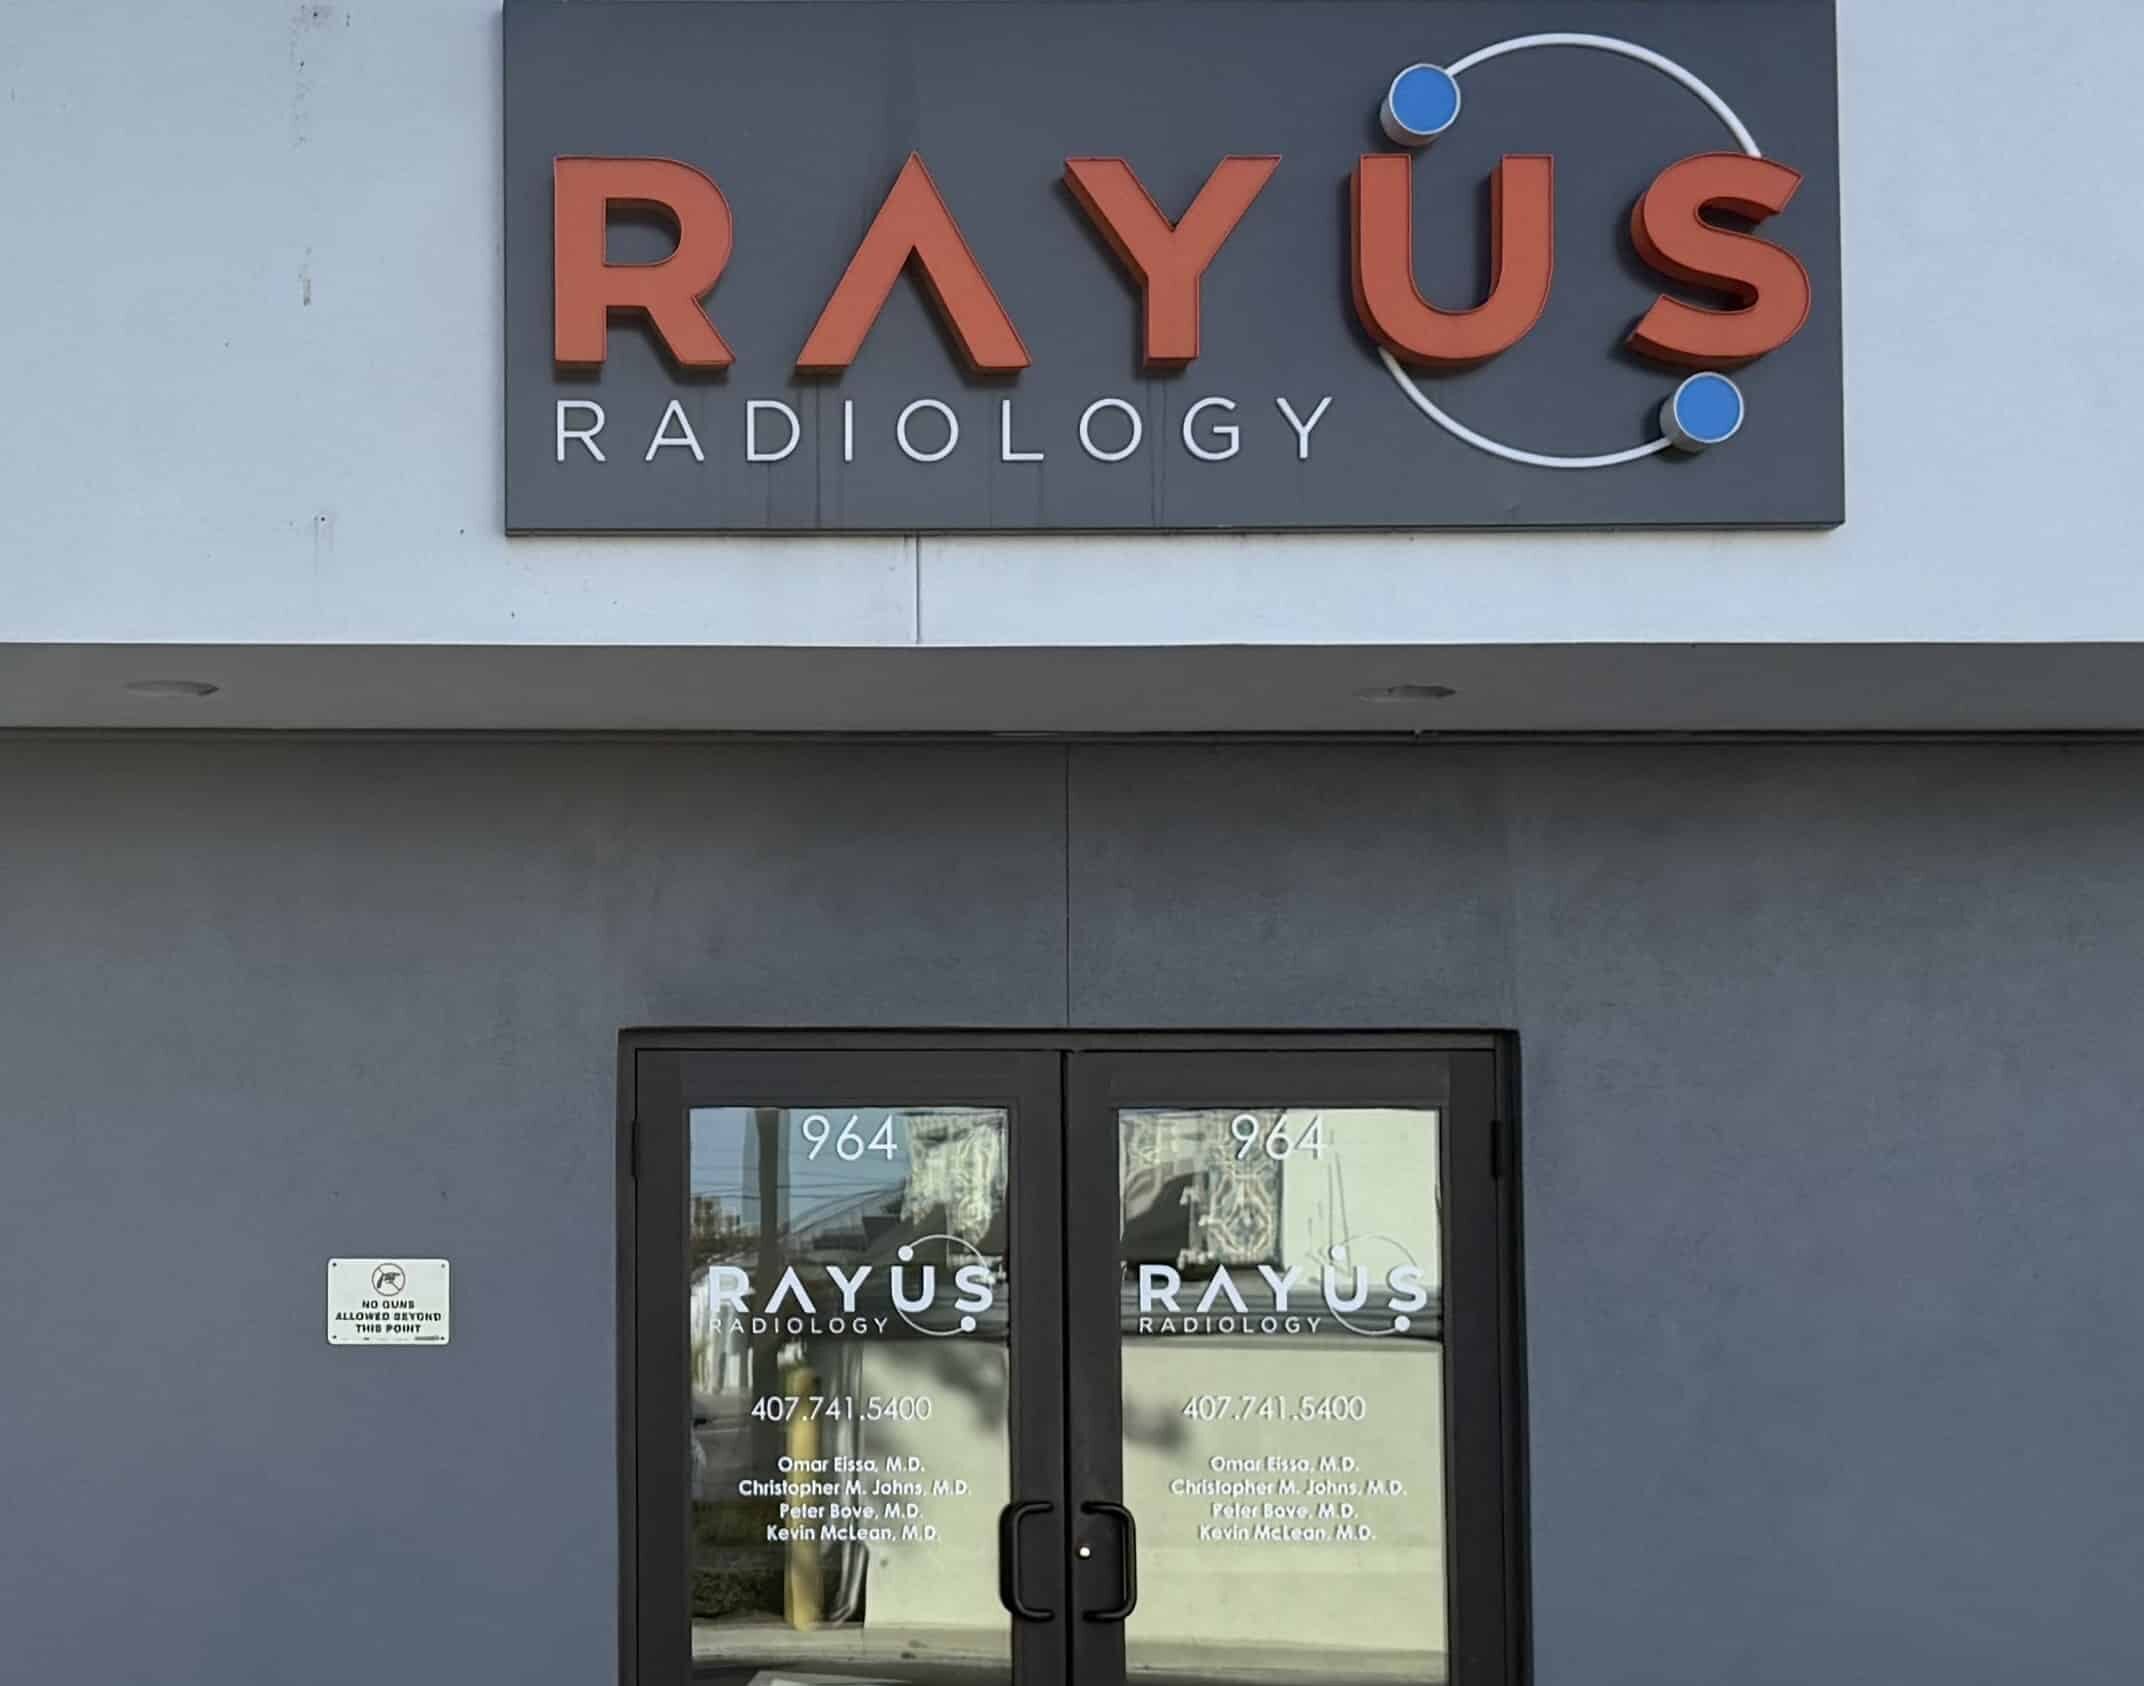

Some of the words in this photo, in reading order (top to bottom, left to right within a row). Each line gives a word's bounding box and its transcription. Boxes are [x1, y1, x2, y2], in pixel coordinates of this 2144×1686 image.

[552, 150, 1811, 374] RAYUS
[555, 396, 1333, 463] RADIOLOGY
[802, 1114, 897, 1160] 964
[1232, 1114, 1327, 1160] 964
[709, 1265, 993, 1313] RAYUS
[1139, 1264, 1427, 1312] RAYUS
[361, 1299, 379, 1310] NO
[335, 1311, 390, 1321] ALLOWED
[393, 1311, 442, 1321] BEYOND
[1139, 1317, 1321, 1333] RADIOLOGY
[355, 1323, 382, 1334] THIS
[385, 1323, 421, 1334] POINT
[709, 1318, 888, 1334] RADIOLOGY
[751, 1396, 932, 1421] 407.741.5400
[1183, 1396, 1366, 1421] 407.741.5400
[777, 1456, 828, 1473] Omar
[833, 1456, 878, 1474] Eissa,
[885, 1456, 926, 1473] M.D.
[1209, 1456, 1262, 1473] Omar
[1267, 1456, 1314, 1474] Eissa,
[1319, 1456, 1360, 1473] M.D.
[738, 1479, 840, 1498] Christopher
[845, 1479, 867, 1496] M.
[871, 1479, 927, 1497] Johns,
[932, 1479, 972, 1496] M.D.
[1169, 1479, 1274, 1498] Christopher
[1278, 1479, 1301, 1496] M.
[1305, 1479, 1362, 1497] Johns,
[1366, 1479, 1408, 1496] M.D.
[779, 1503, 824, 1520] Peter
[829, 1503, 879, 1520] Bove,
[884, 1503, 924, 1520] M.D.
[1211, 1503, 1258, 1520] Peter
[1263, 1503, 1313, 1520] Bove,
[1318, 1503, 1358, 1520] M.D.
[766, 1524, 815, 1542] Kevin
[820, 1524, 896, 1542] McLean,
[902, 1524, 941, 1542] M.D.
[1198, 1524, 1250, 1542] Kevin
[1254, 1524, 1331, 1542] McLean,
[1335, 1524, 1376, 1542] M.D.
